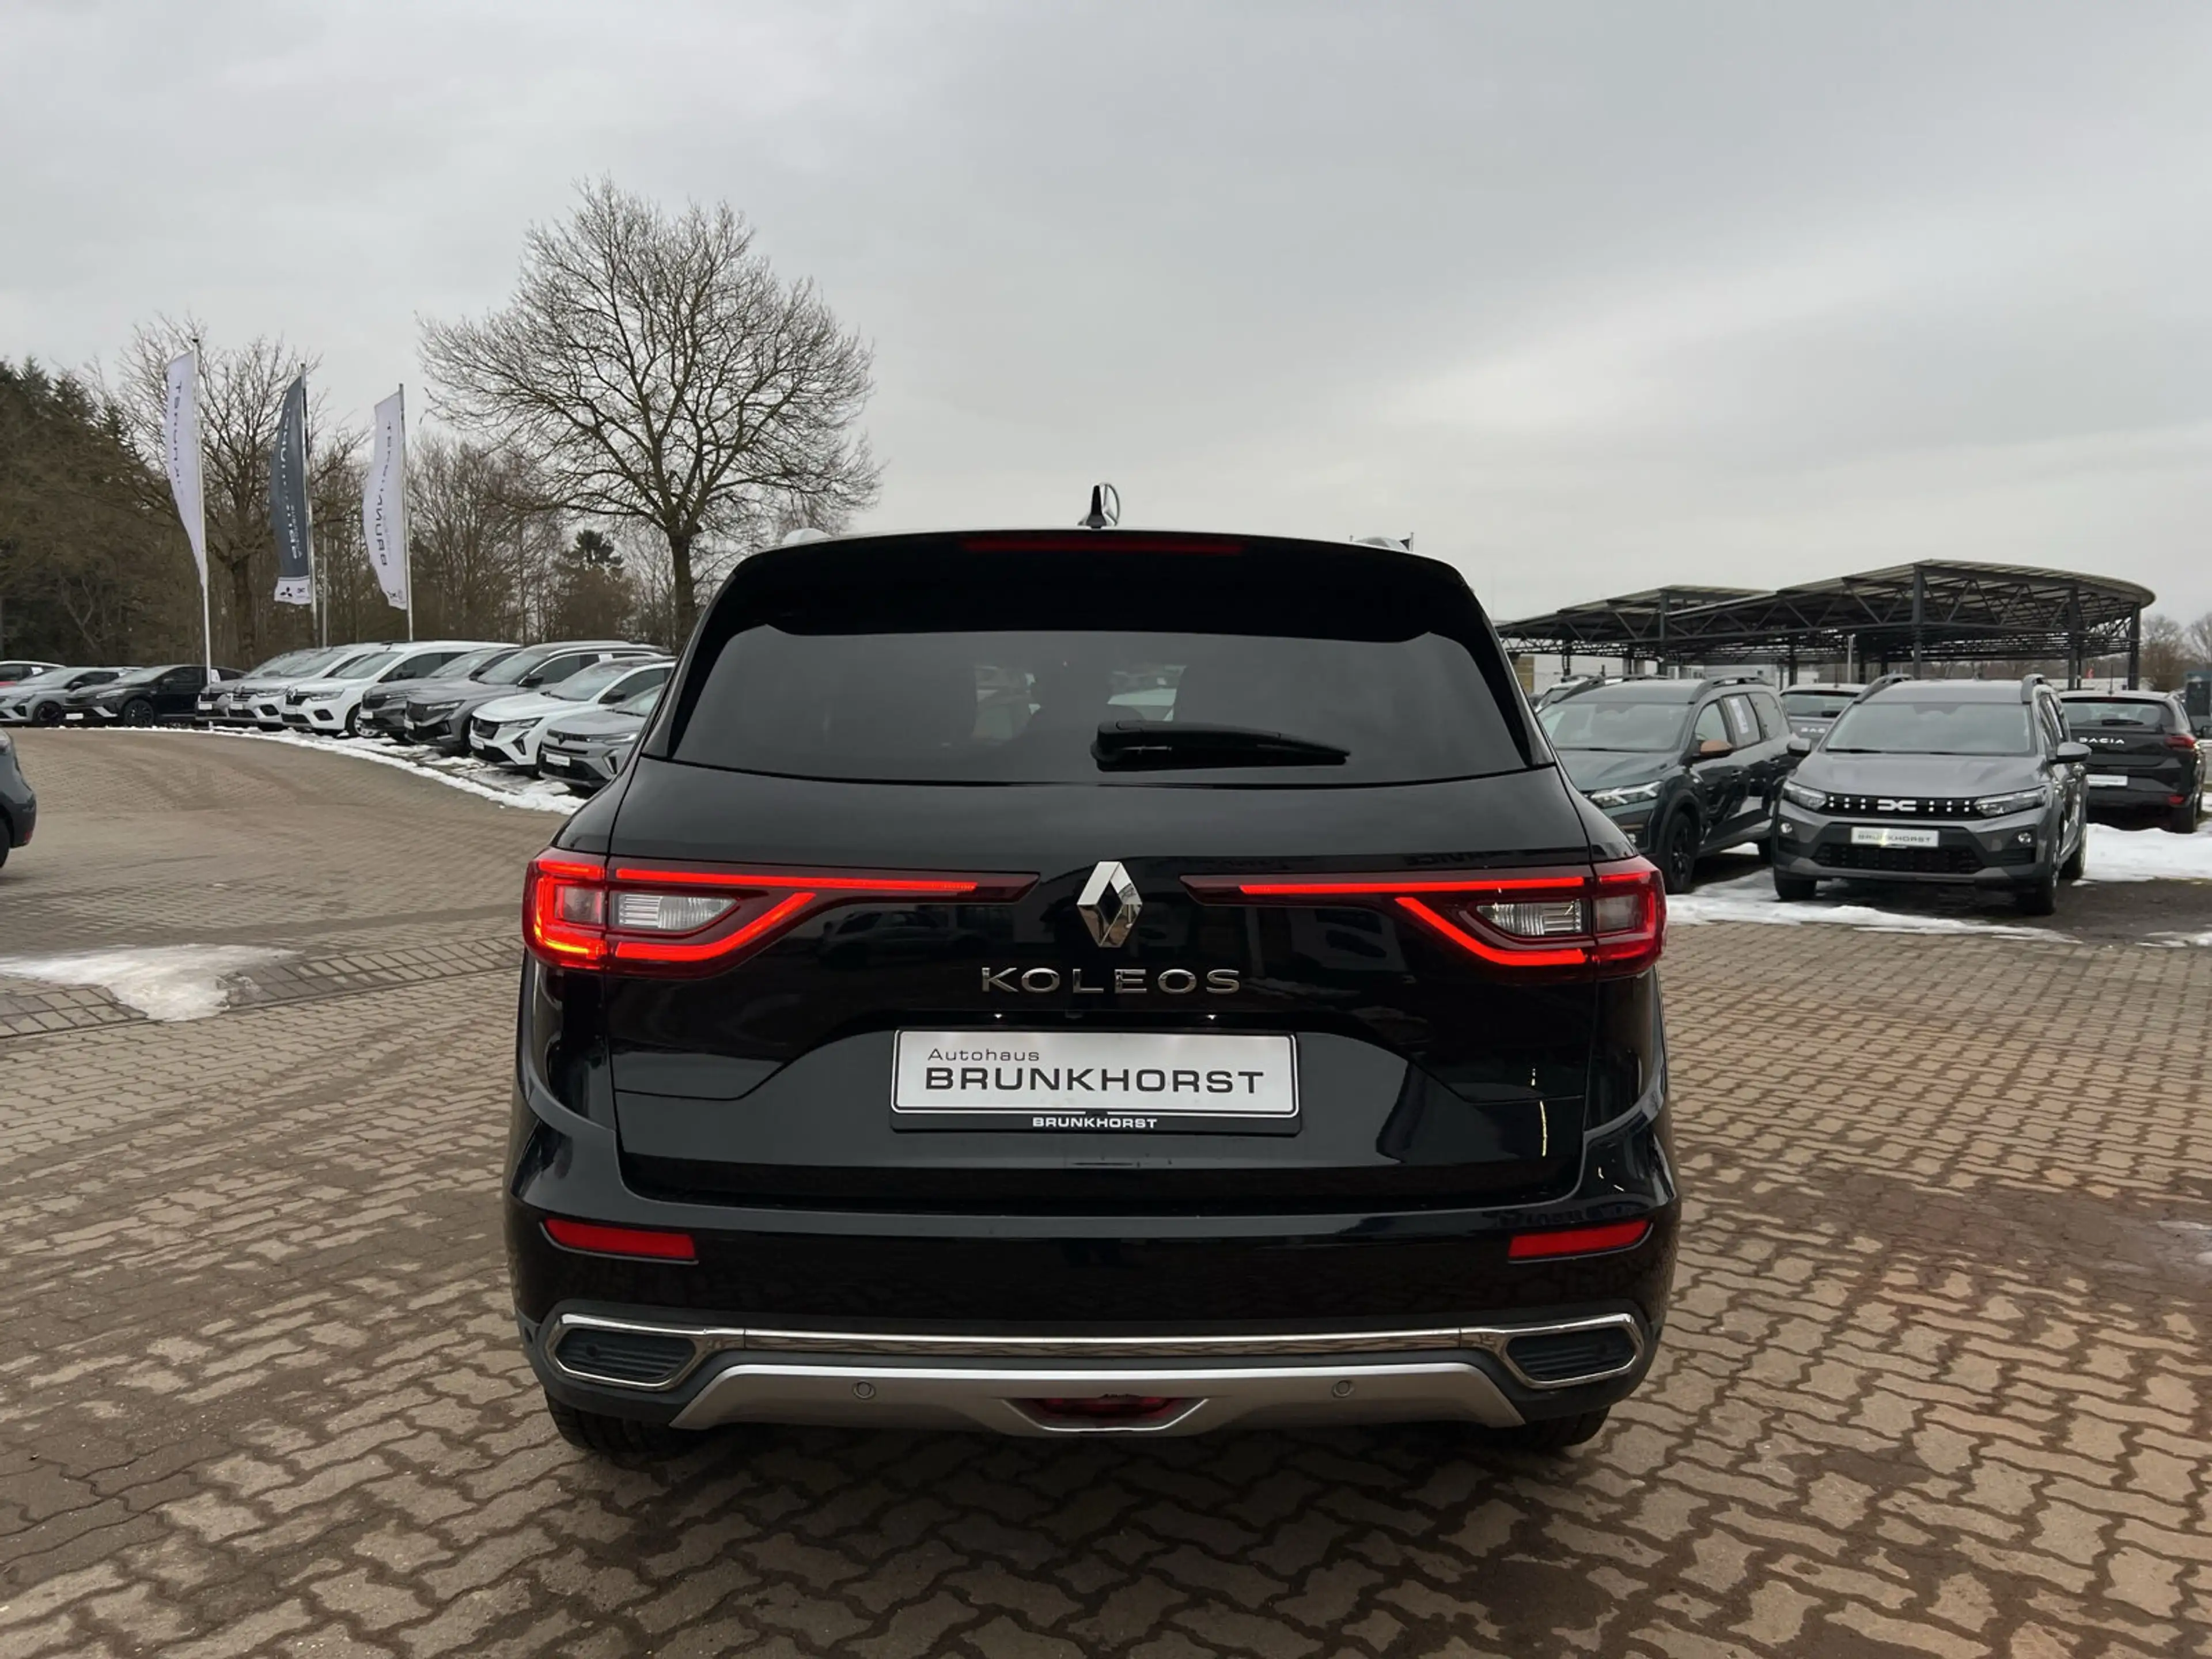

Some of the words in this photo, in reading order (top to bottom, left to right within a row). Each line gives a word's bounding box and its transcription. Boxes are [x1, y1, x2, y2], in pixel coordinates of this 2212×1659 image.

[982, 968, 1240, 994] KOLEOS
[928, 1048, 1040, 1061] Autohaus
[926, 1067, 1263, 1093] BRUNKHORST
[1033, 1118, 1157, 1128] BRUNKHORST
